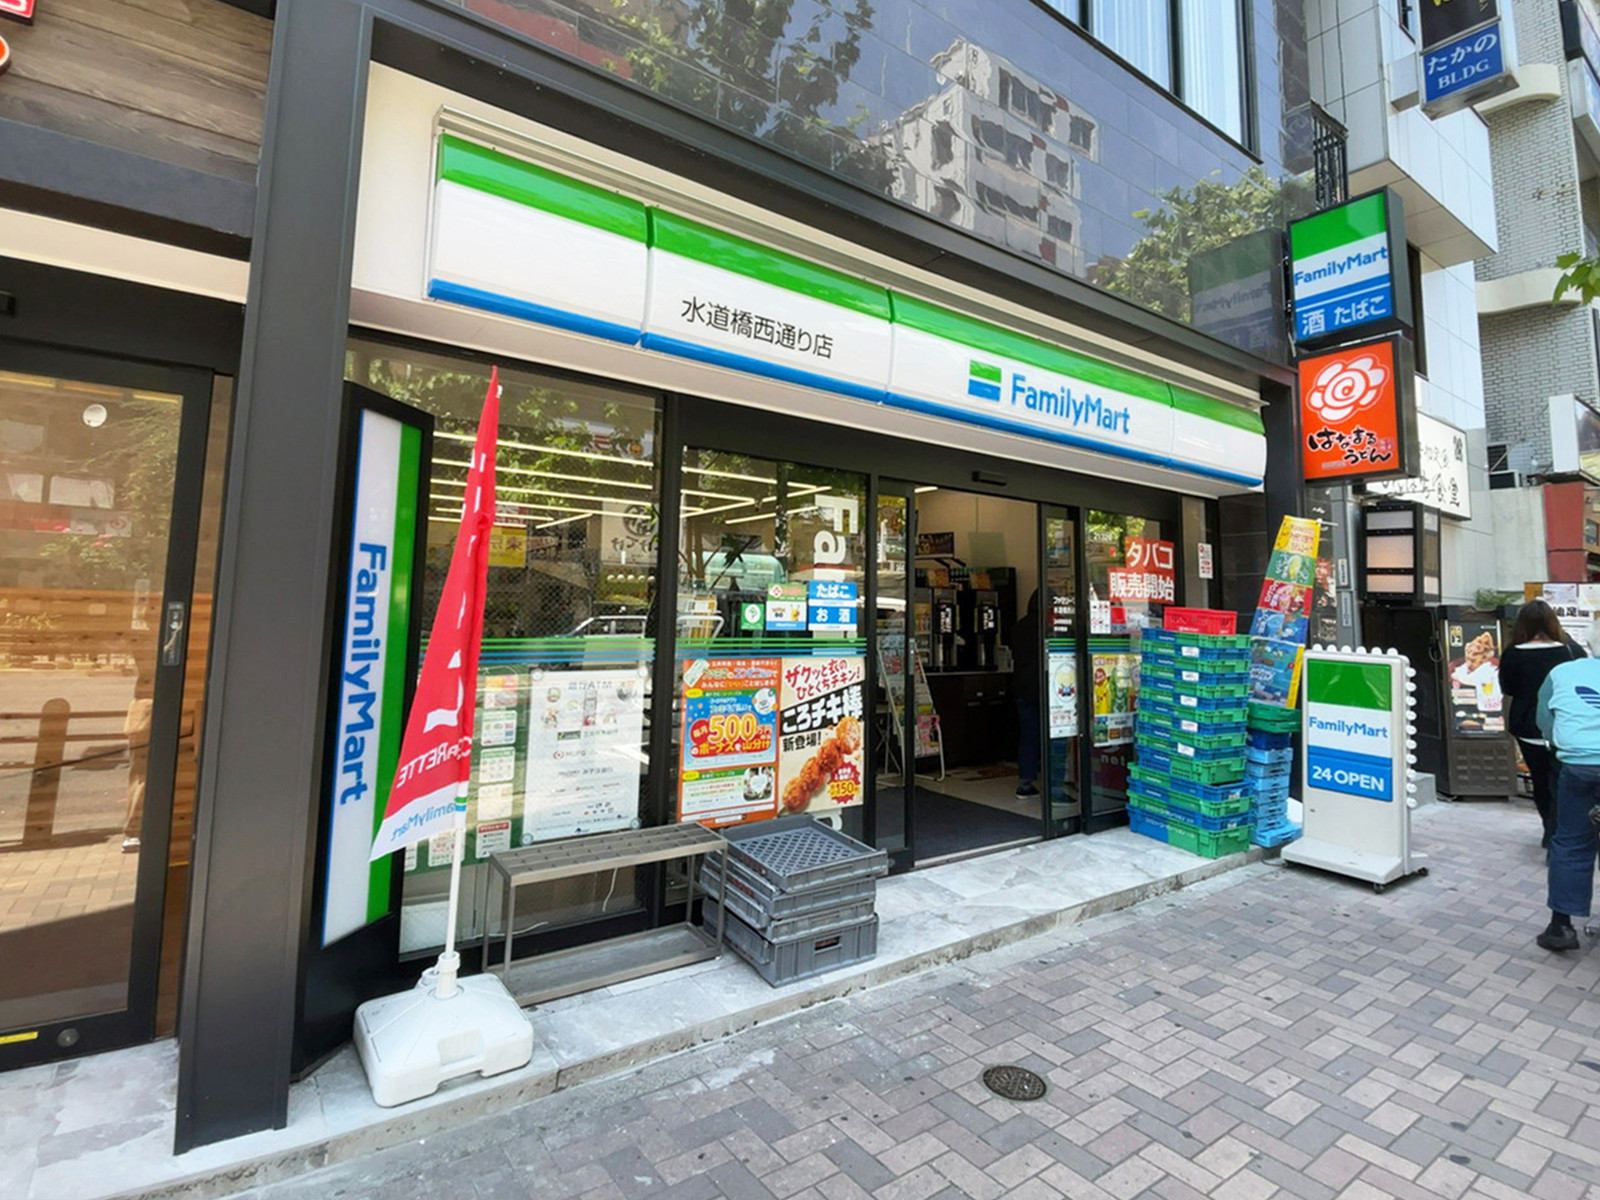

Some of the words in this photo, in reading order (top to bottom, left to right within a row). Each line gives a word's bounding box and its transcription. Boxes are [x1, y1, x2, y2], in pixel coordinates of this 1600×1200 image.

[1427, 33, 1498, 76] たかの
[1437, 59, 1490, 91] BLDG
[1293, 245, 1388, 286] FamilyMart
[681, 296, 834, 360] 水道橋西通り店
[1302, 308, 1325, 335] 酒
[1334, 295, 1387, 326] たばこ
[1010, 372, 1131, 435] FamilyMart
[1308, 427, 1377, 450] はなまる
[1344, 445, 1392, 465] うどん
[1126, 541, 1174, 570] タバコ
[816, 583, 852, 599] たばこ
[1109, 572, 1175, 600] 販売開始
[340, 542, 388, 805] FamilyMart
[785, 659, 848, 688] ザクッと衣の
[783, 685, 863, 733] ころチキ棒
[707, 712, 758, 745] 500
[783, 731, 821, 752] 新登場!
[1308, 716, 1389, 739] FamilyMart
[1312, 765, 1332, 782] 24
[1334, 769, 1385, 793] OPEN
